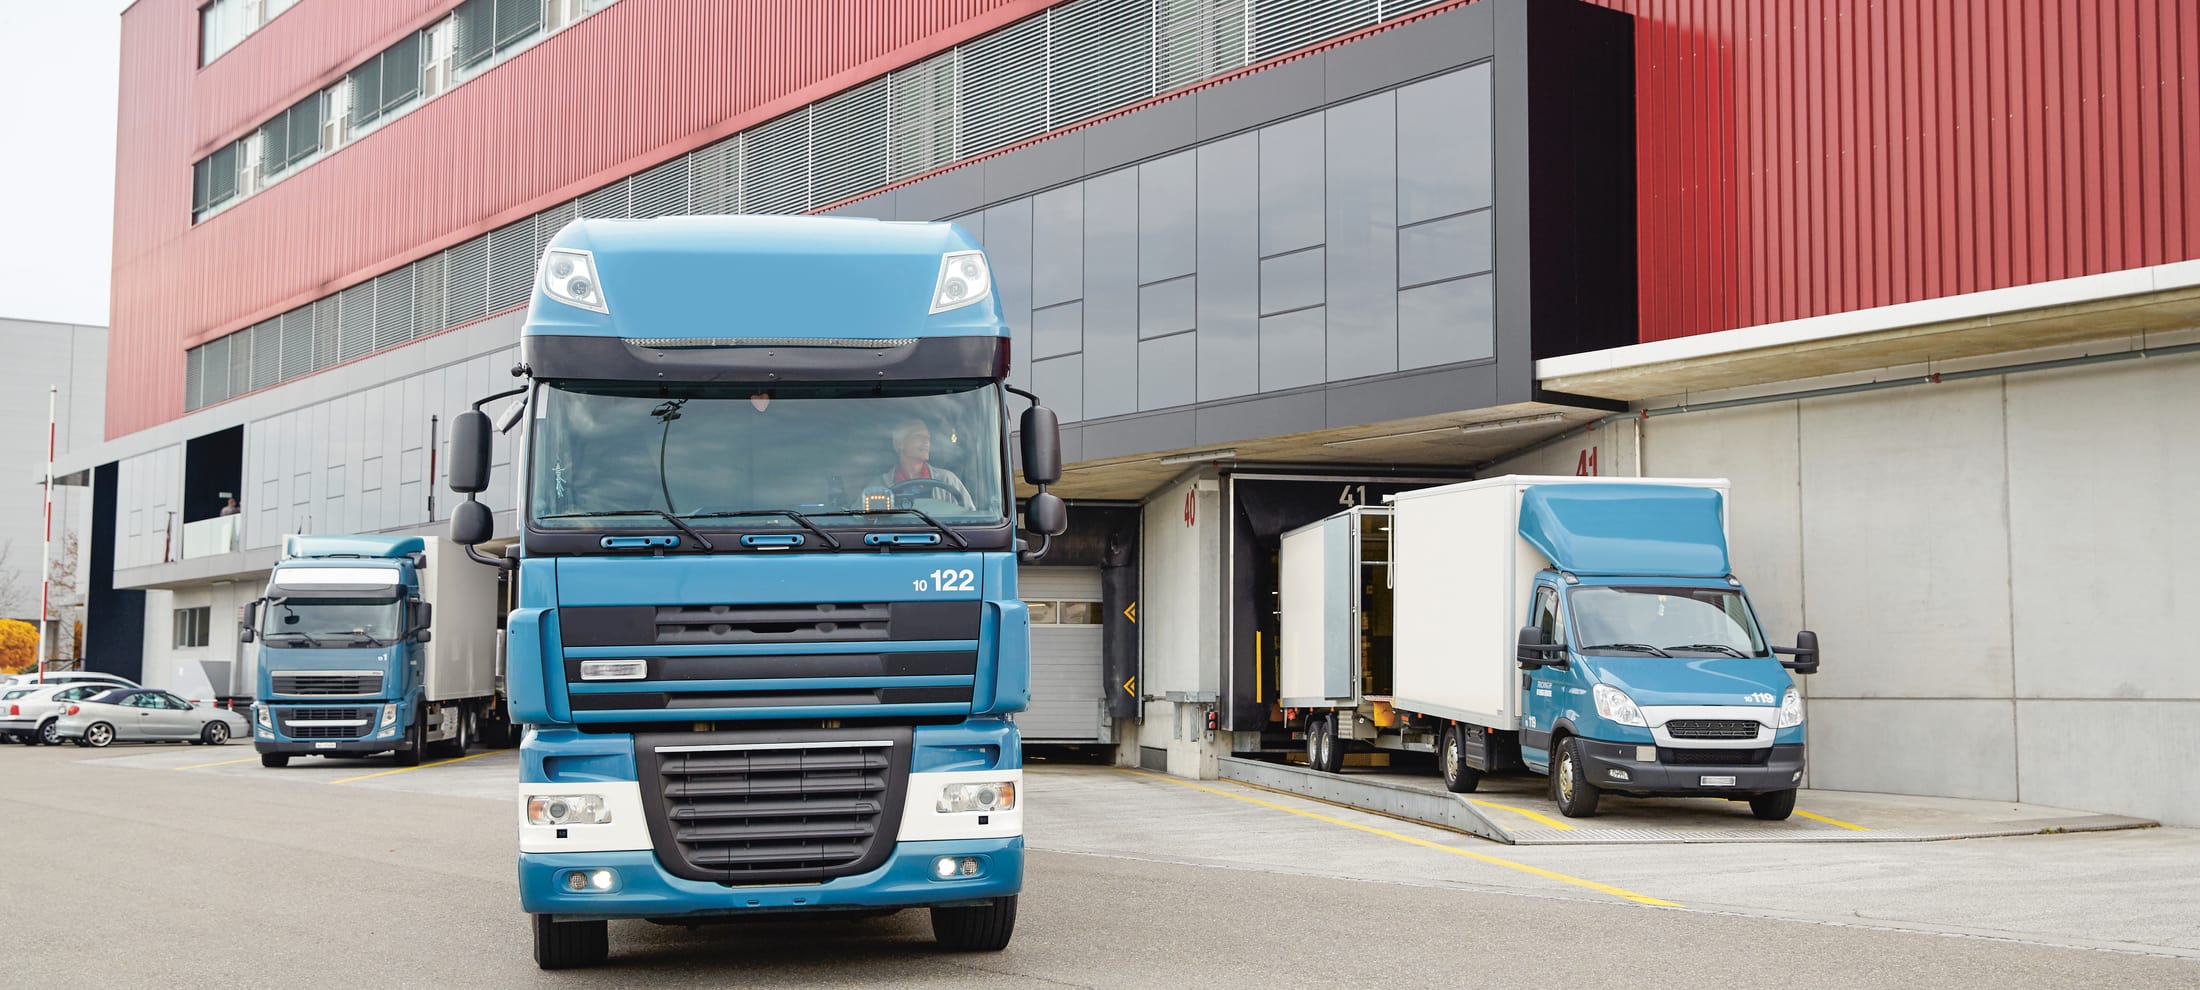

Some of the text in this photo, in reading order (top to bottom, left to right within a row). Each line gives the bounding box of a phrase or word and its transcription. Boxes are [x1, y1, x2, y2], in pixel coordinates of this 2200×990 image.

[1576, 446, 1597, 476] 41
[1339, 485, 1365, 507] 41
[1184, 489, 1196, 528] 40
[912, 569, 975, 592] 10 122
[1751, 692, 1774, 704] 119
